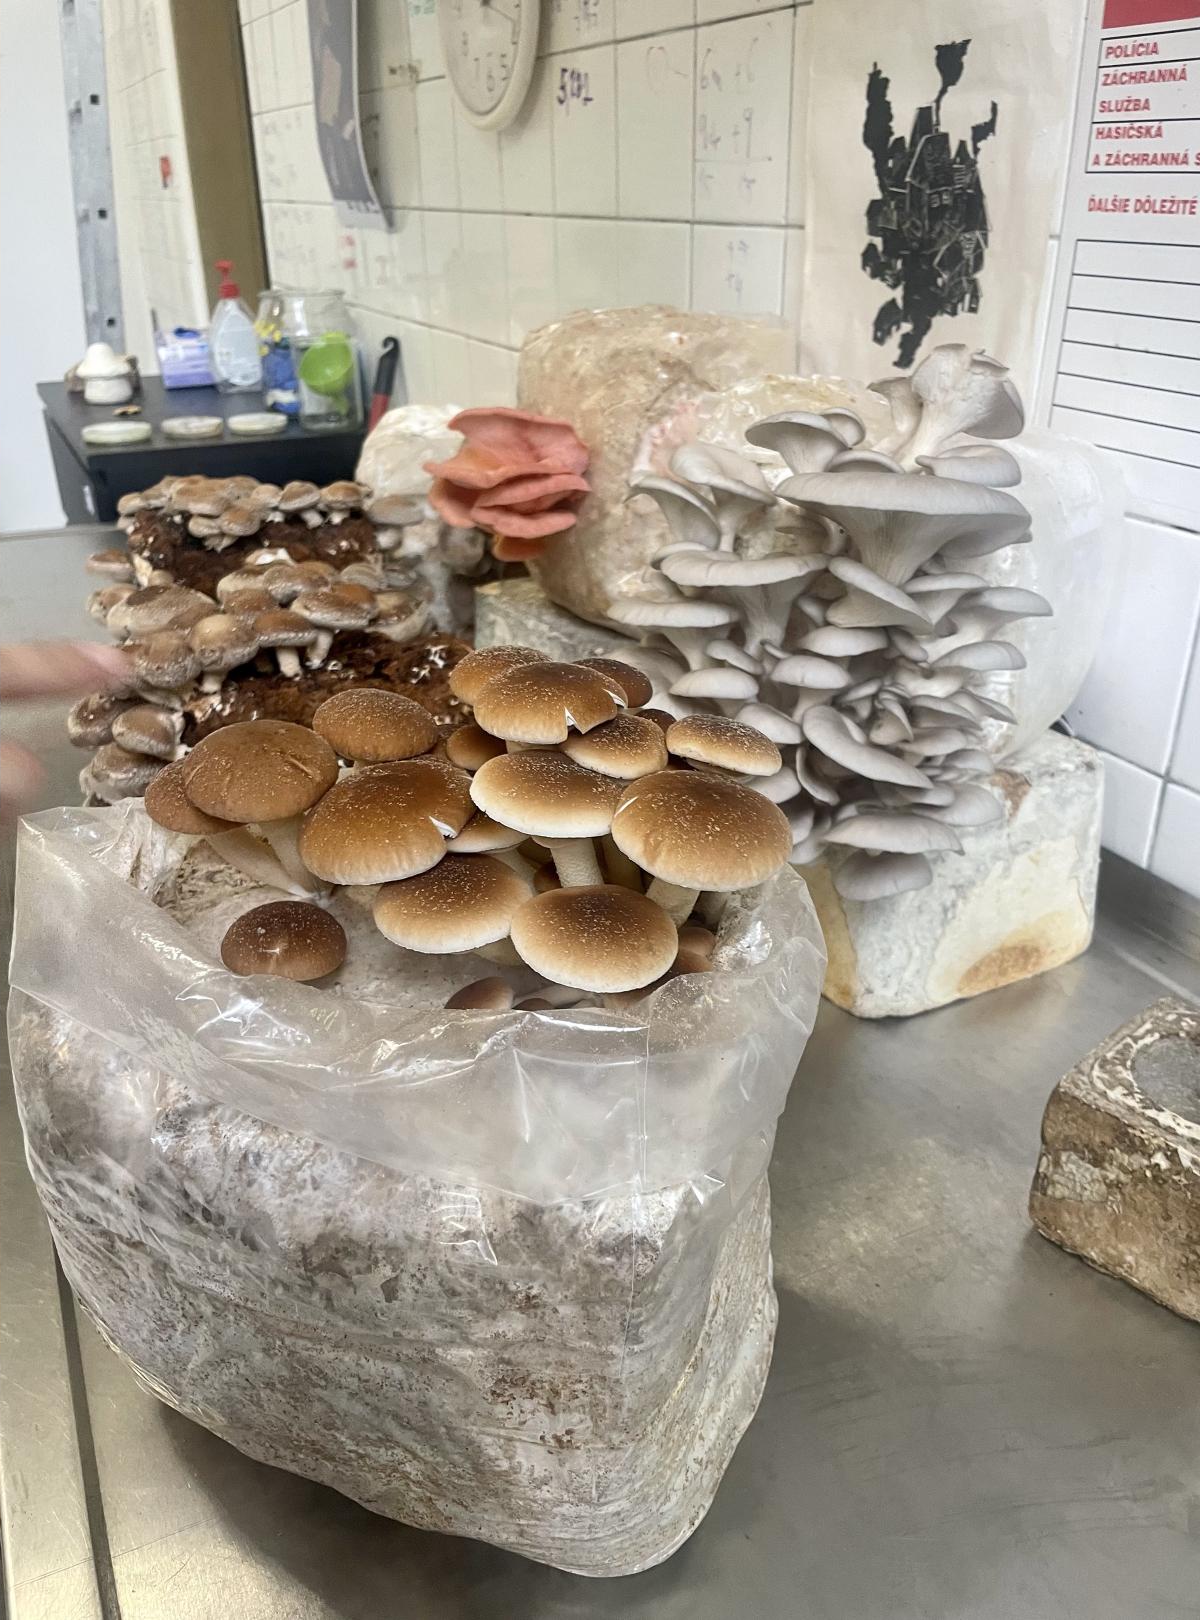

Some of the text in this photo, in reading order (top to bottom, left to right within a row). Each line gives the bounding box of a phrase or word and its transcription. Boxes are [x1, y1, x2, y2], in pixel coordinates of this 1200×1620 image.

[1105, 40, 1159, 59] POLÍCIA
[1102, 64, 1188, 86] ZÁCHRANNÁ
[1098, 96, 1151, 113] SLUŽBA
[1095, 122, 1163, 139] HASIČSKÁ
[1092, 153, 1100, 166] A
[1105, 149, 1189, 166] ZÁCHRANNÁ
[1088, 194, 1198, 215] ĎALŠIE DÔLEŽITÉ
